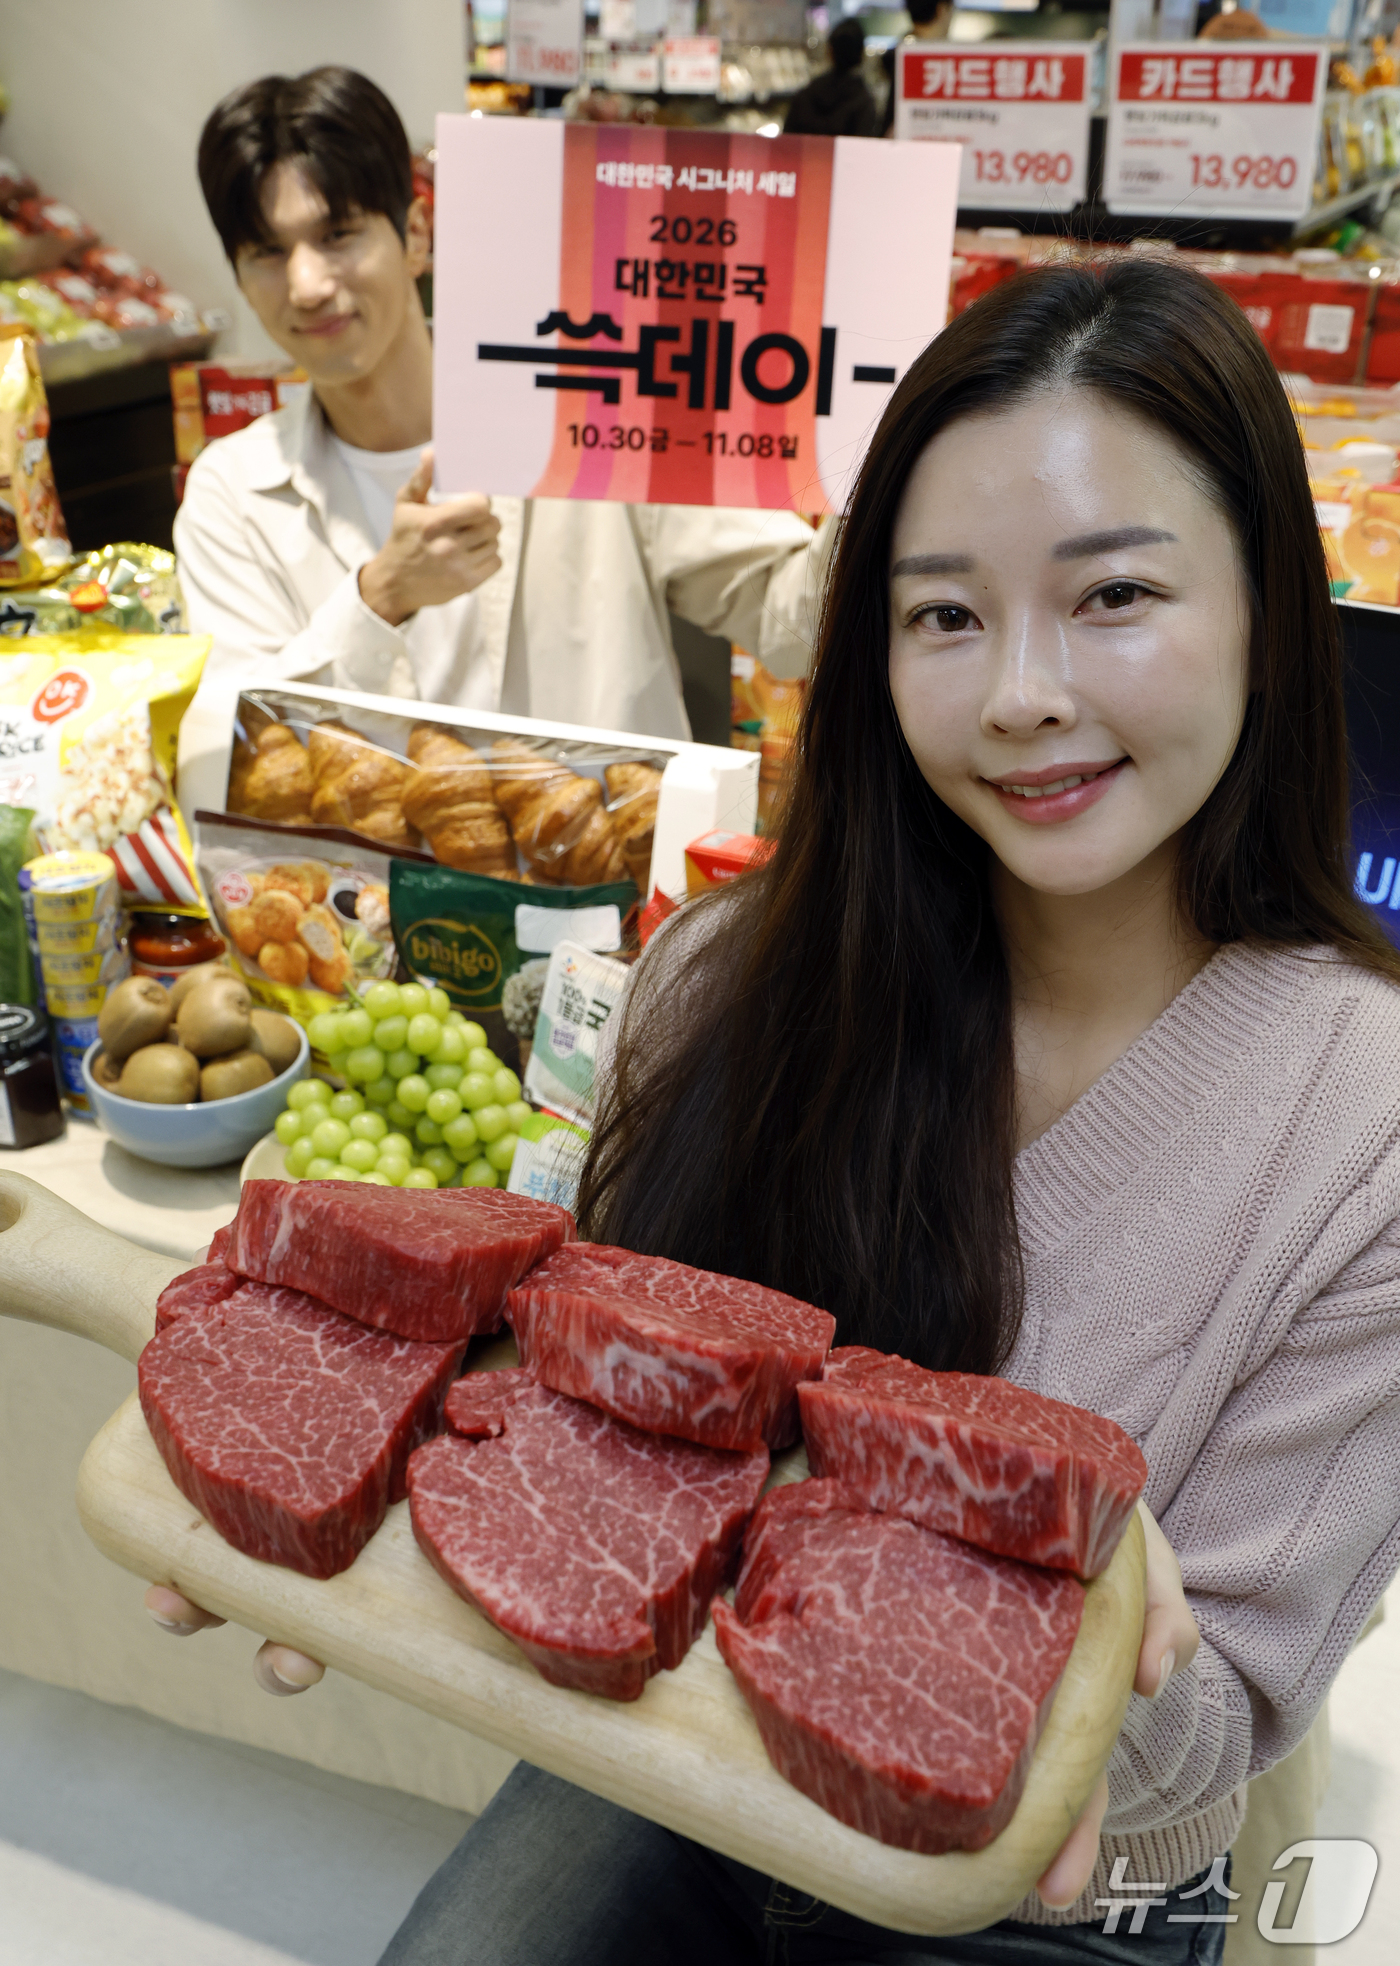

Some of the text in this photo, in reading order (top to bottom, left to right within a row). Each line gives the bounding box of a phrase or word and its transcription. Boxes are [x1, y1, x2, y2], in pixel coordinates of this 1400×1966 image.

[923, 58, 1065, 98] 카드행사
[1139, 58, 1294, 99] 카드행사
[596, 161, 797, 198] 대한민국 시그니처 세일
[973, 149, 1074, 185] 13,980
[1189, 153, 1298, 191] 13,980
[649, 215, 738, 246] 2026
[614, 257, 768, 305] 대한민국
[477, 311, 837, 416] 쓱데이
[567, 423, 670, 453] 10.30금
[702, 430, 799, 460] 11.08일
[411, 935, 496, 978] bibigo
